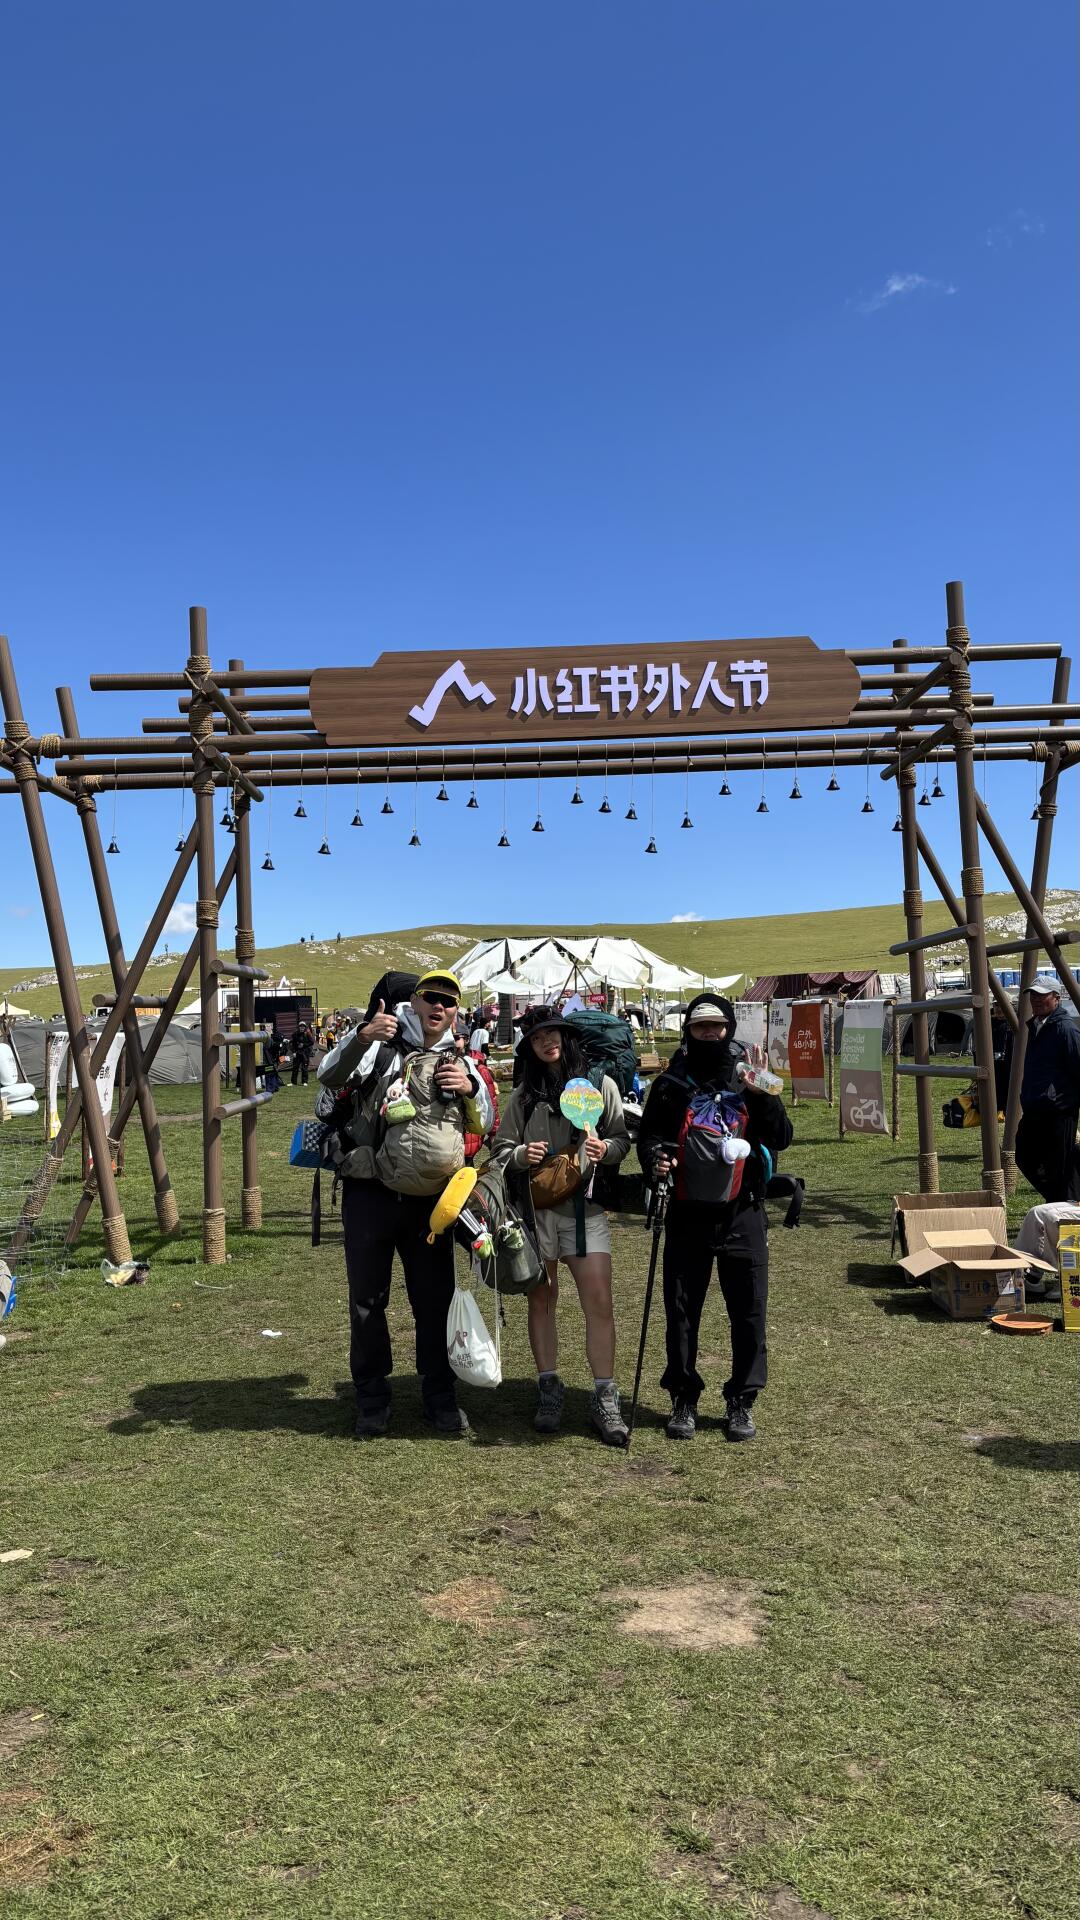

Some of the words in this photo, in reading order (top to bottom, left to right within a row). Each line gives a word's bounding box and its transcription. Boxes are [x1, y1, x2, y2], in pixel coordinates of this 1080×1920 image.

[510, 660, 769, 715] 小红书外人节
[797, 1029, 813, 1039] 户外
[792, 1040, 817, 1050] 48小时
